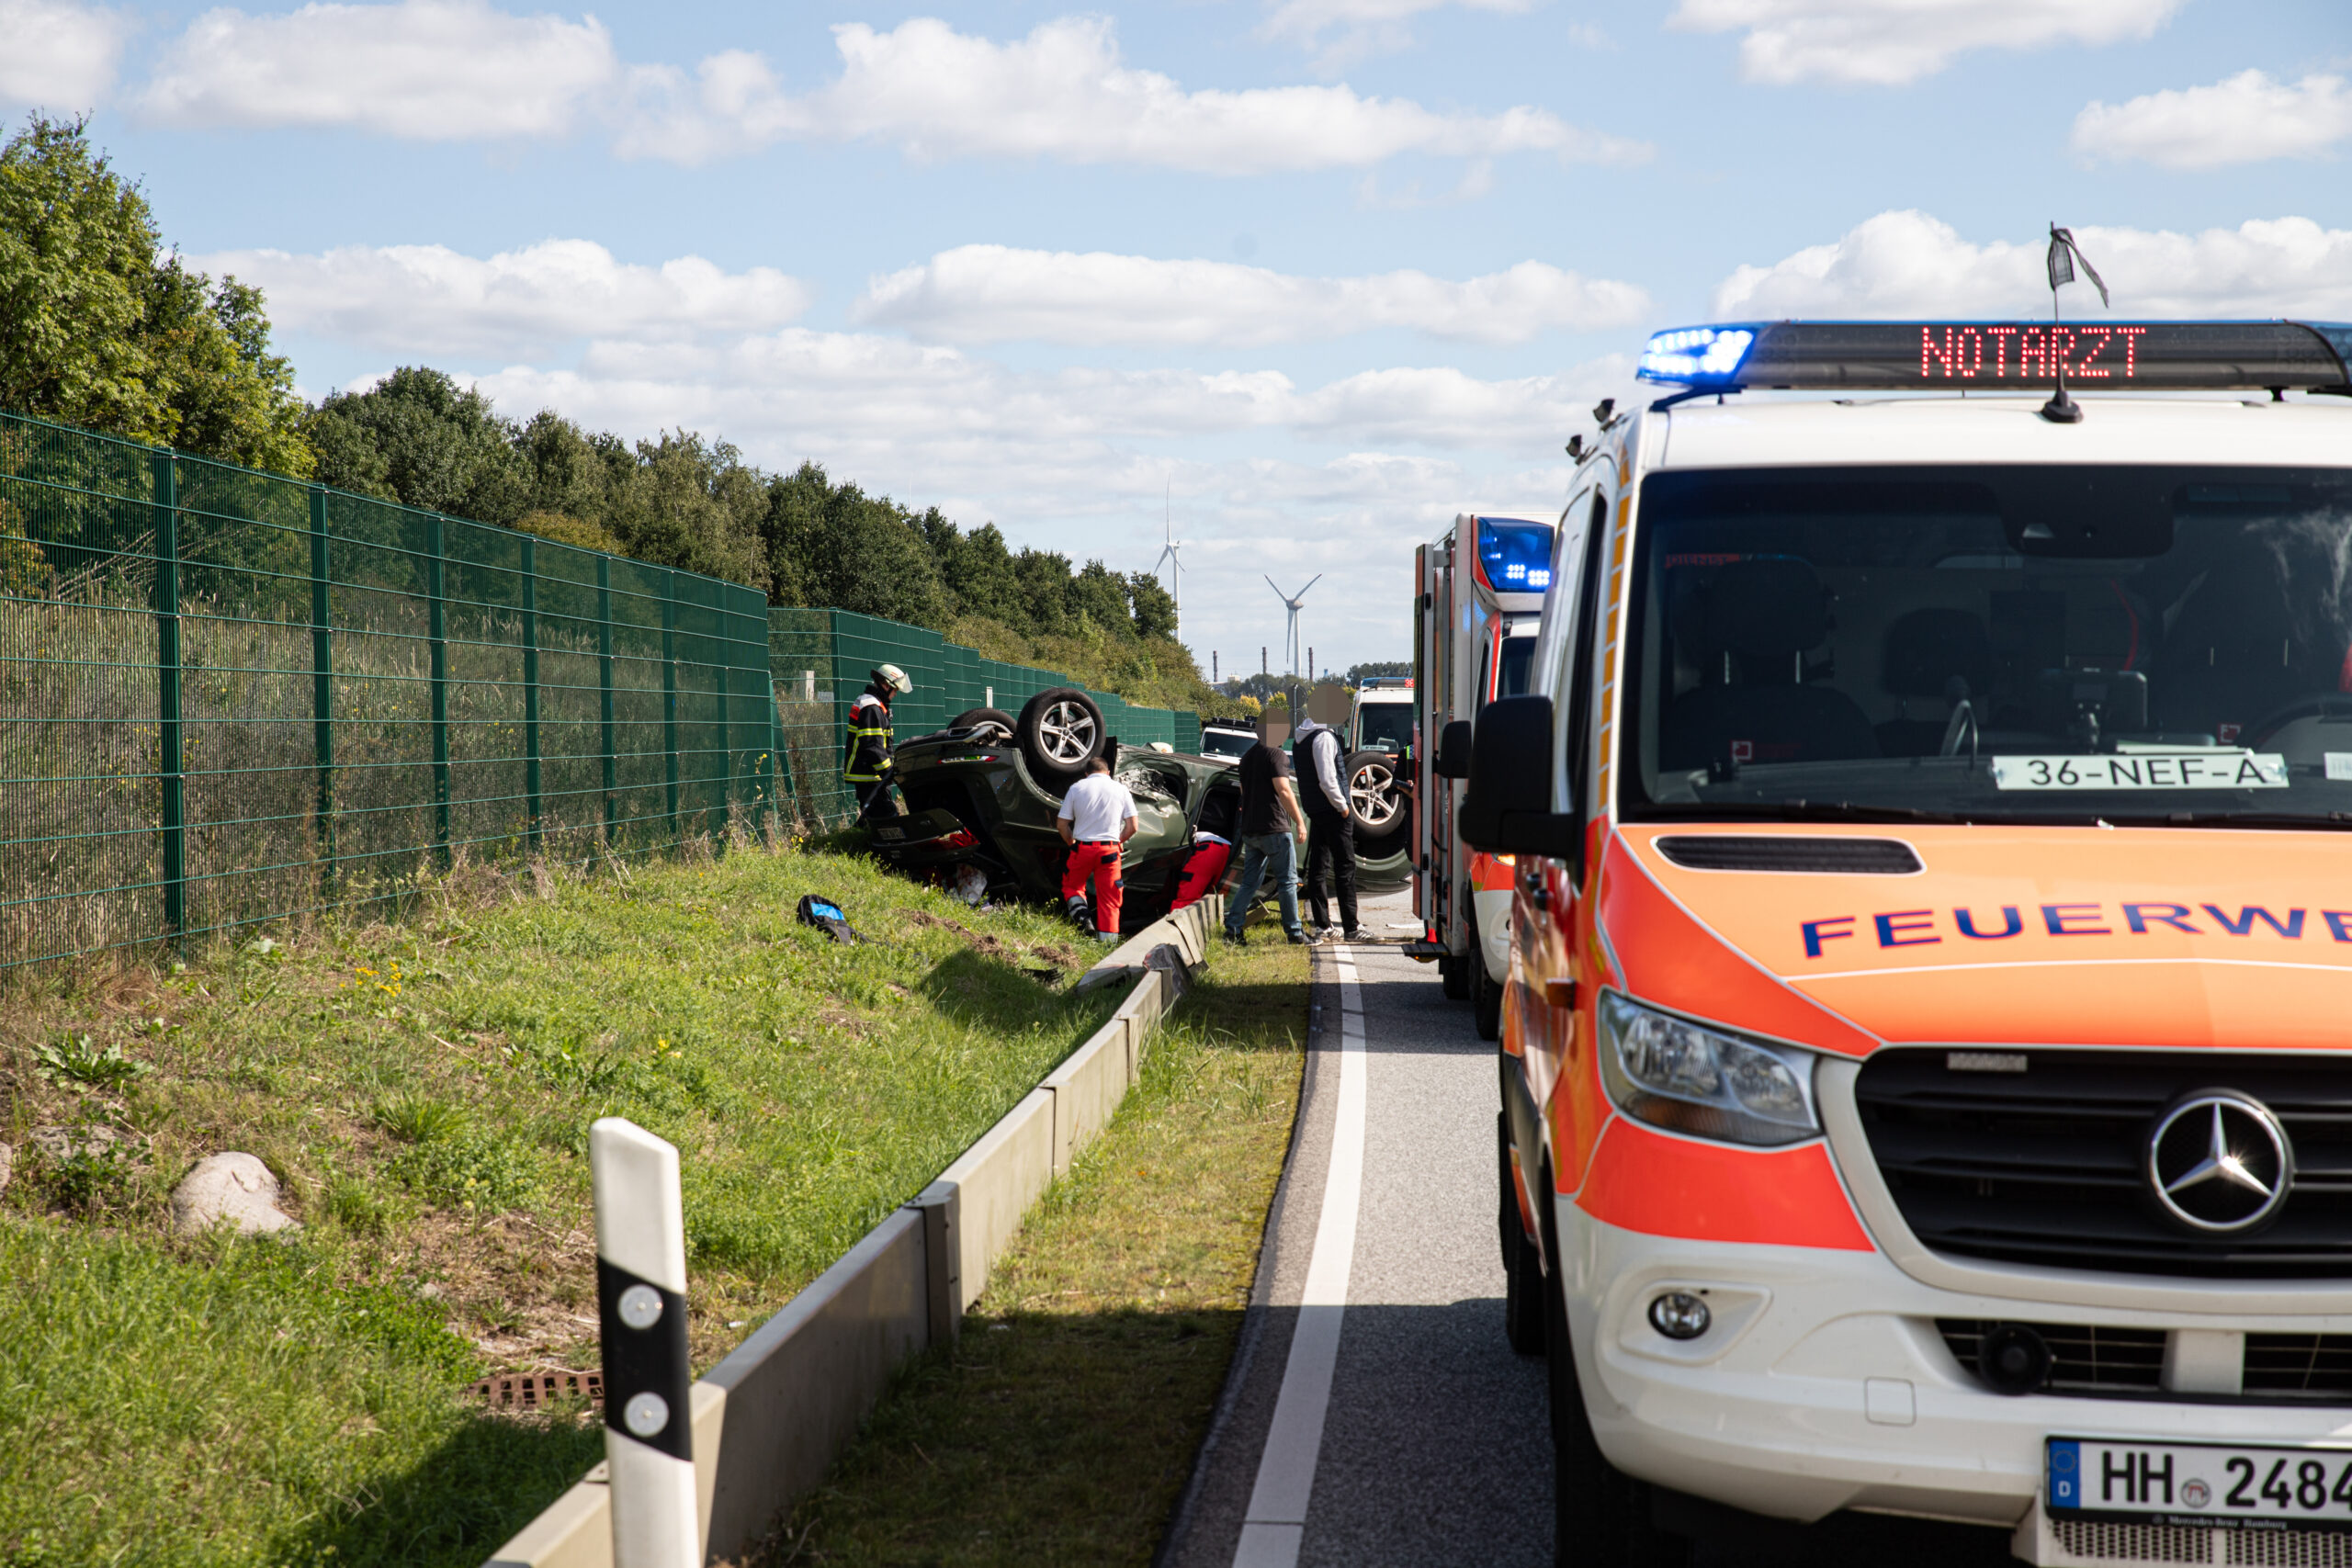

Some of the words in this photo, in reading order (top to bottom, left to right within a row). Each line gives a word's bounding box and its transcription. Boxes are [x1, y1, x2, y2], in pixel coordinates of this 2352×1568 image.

[1922, 326, 2146, 378] NOTARZT
[2027, 758, 2267, 786] 36-NEF-A
[2057, 1480, 2072, 1497] D
[2102, 1450, 2174, 1505] HH
[2225, 1456, 2352, 1513] 2484
